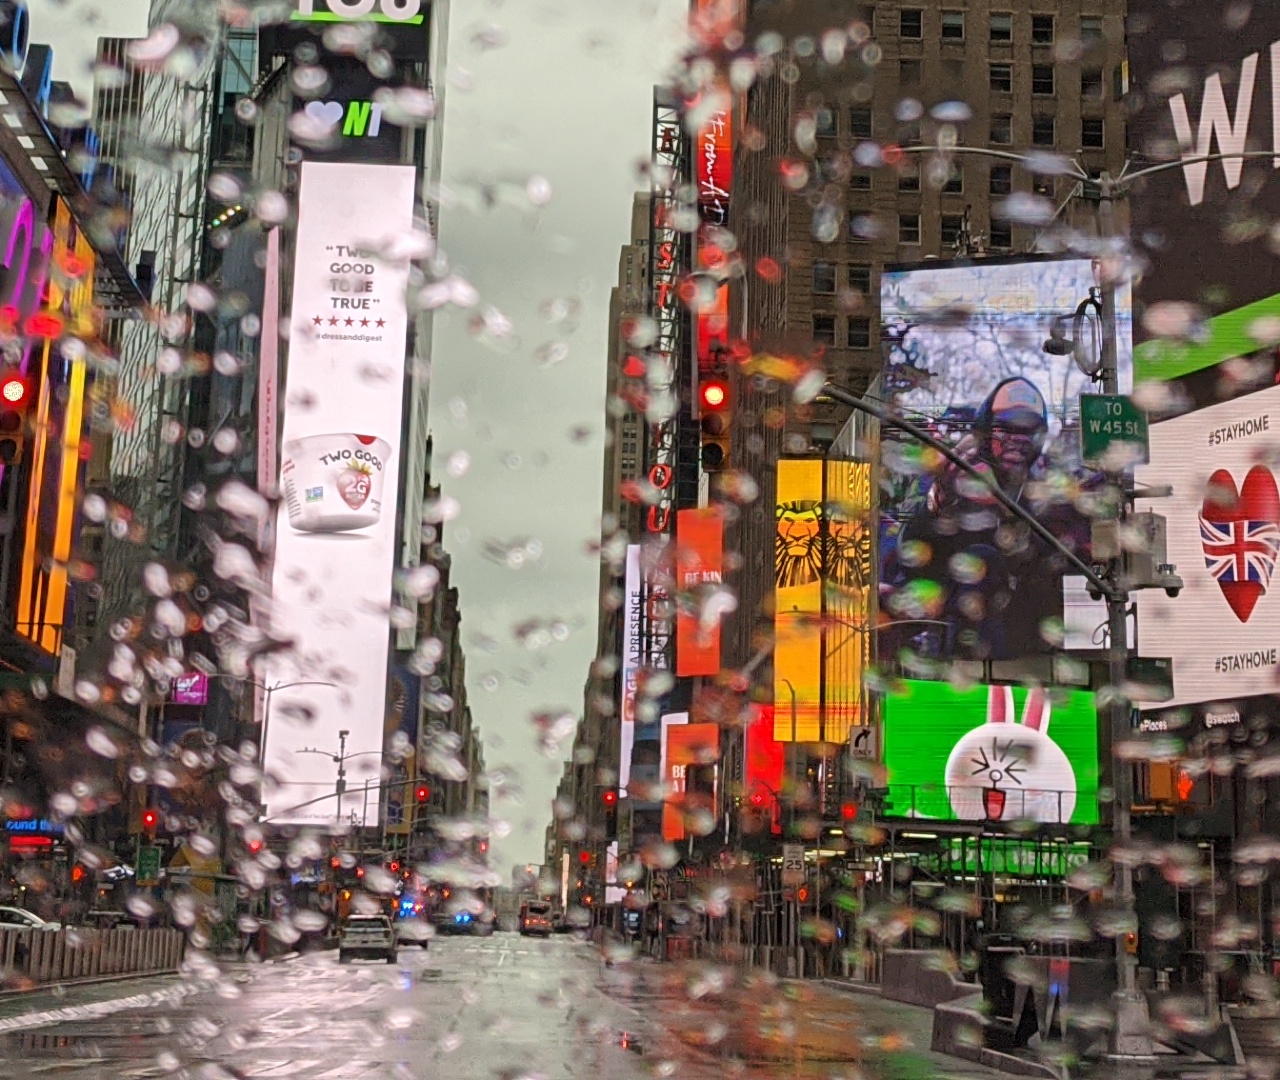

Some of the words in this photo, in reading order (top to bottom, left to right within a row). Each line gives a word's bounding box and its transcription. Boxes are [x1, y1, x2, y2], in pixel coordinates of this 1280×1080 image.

[329, 262, 376, 275] GOOD
[1103, 401, 1123, 416] TO
[1089, 419, 1101, 434] W
[1103, 421, 1123, 435] 45
[1124, 421, 1140, 435] St
[1207, 414, 1270, 447] #STAYHOME
[318, 449, 352, 466] TWO
[353, 449, 383, 472] GOOD
[628, 589, 642, 652] PRESENCE
[1214, 648, 1278, 673] #STAYHOME
[852, 748, 872, 757] ONLY
[785, 859, 804, 871] 25
